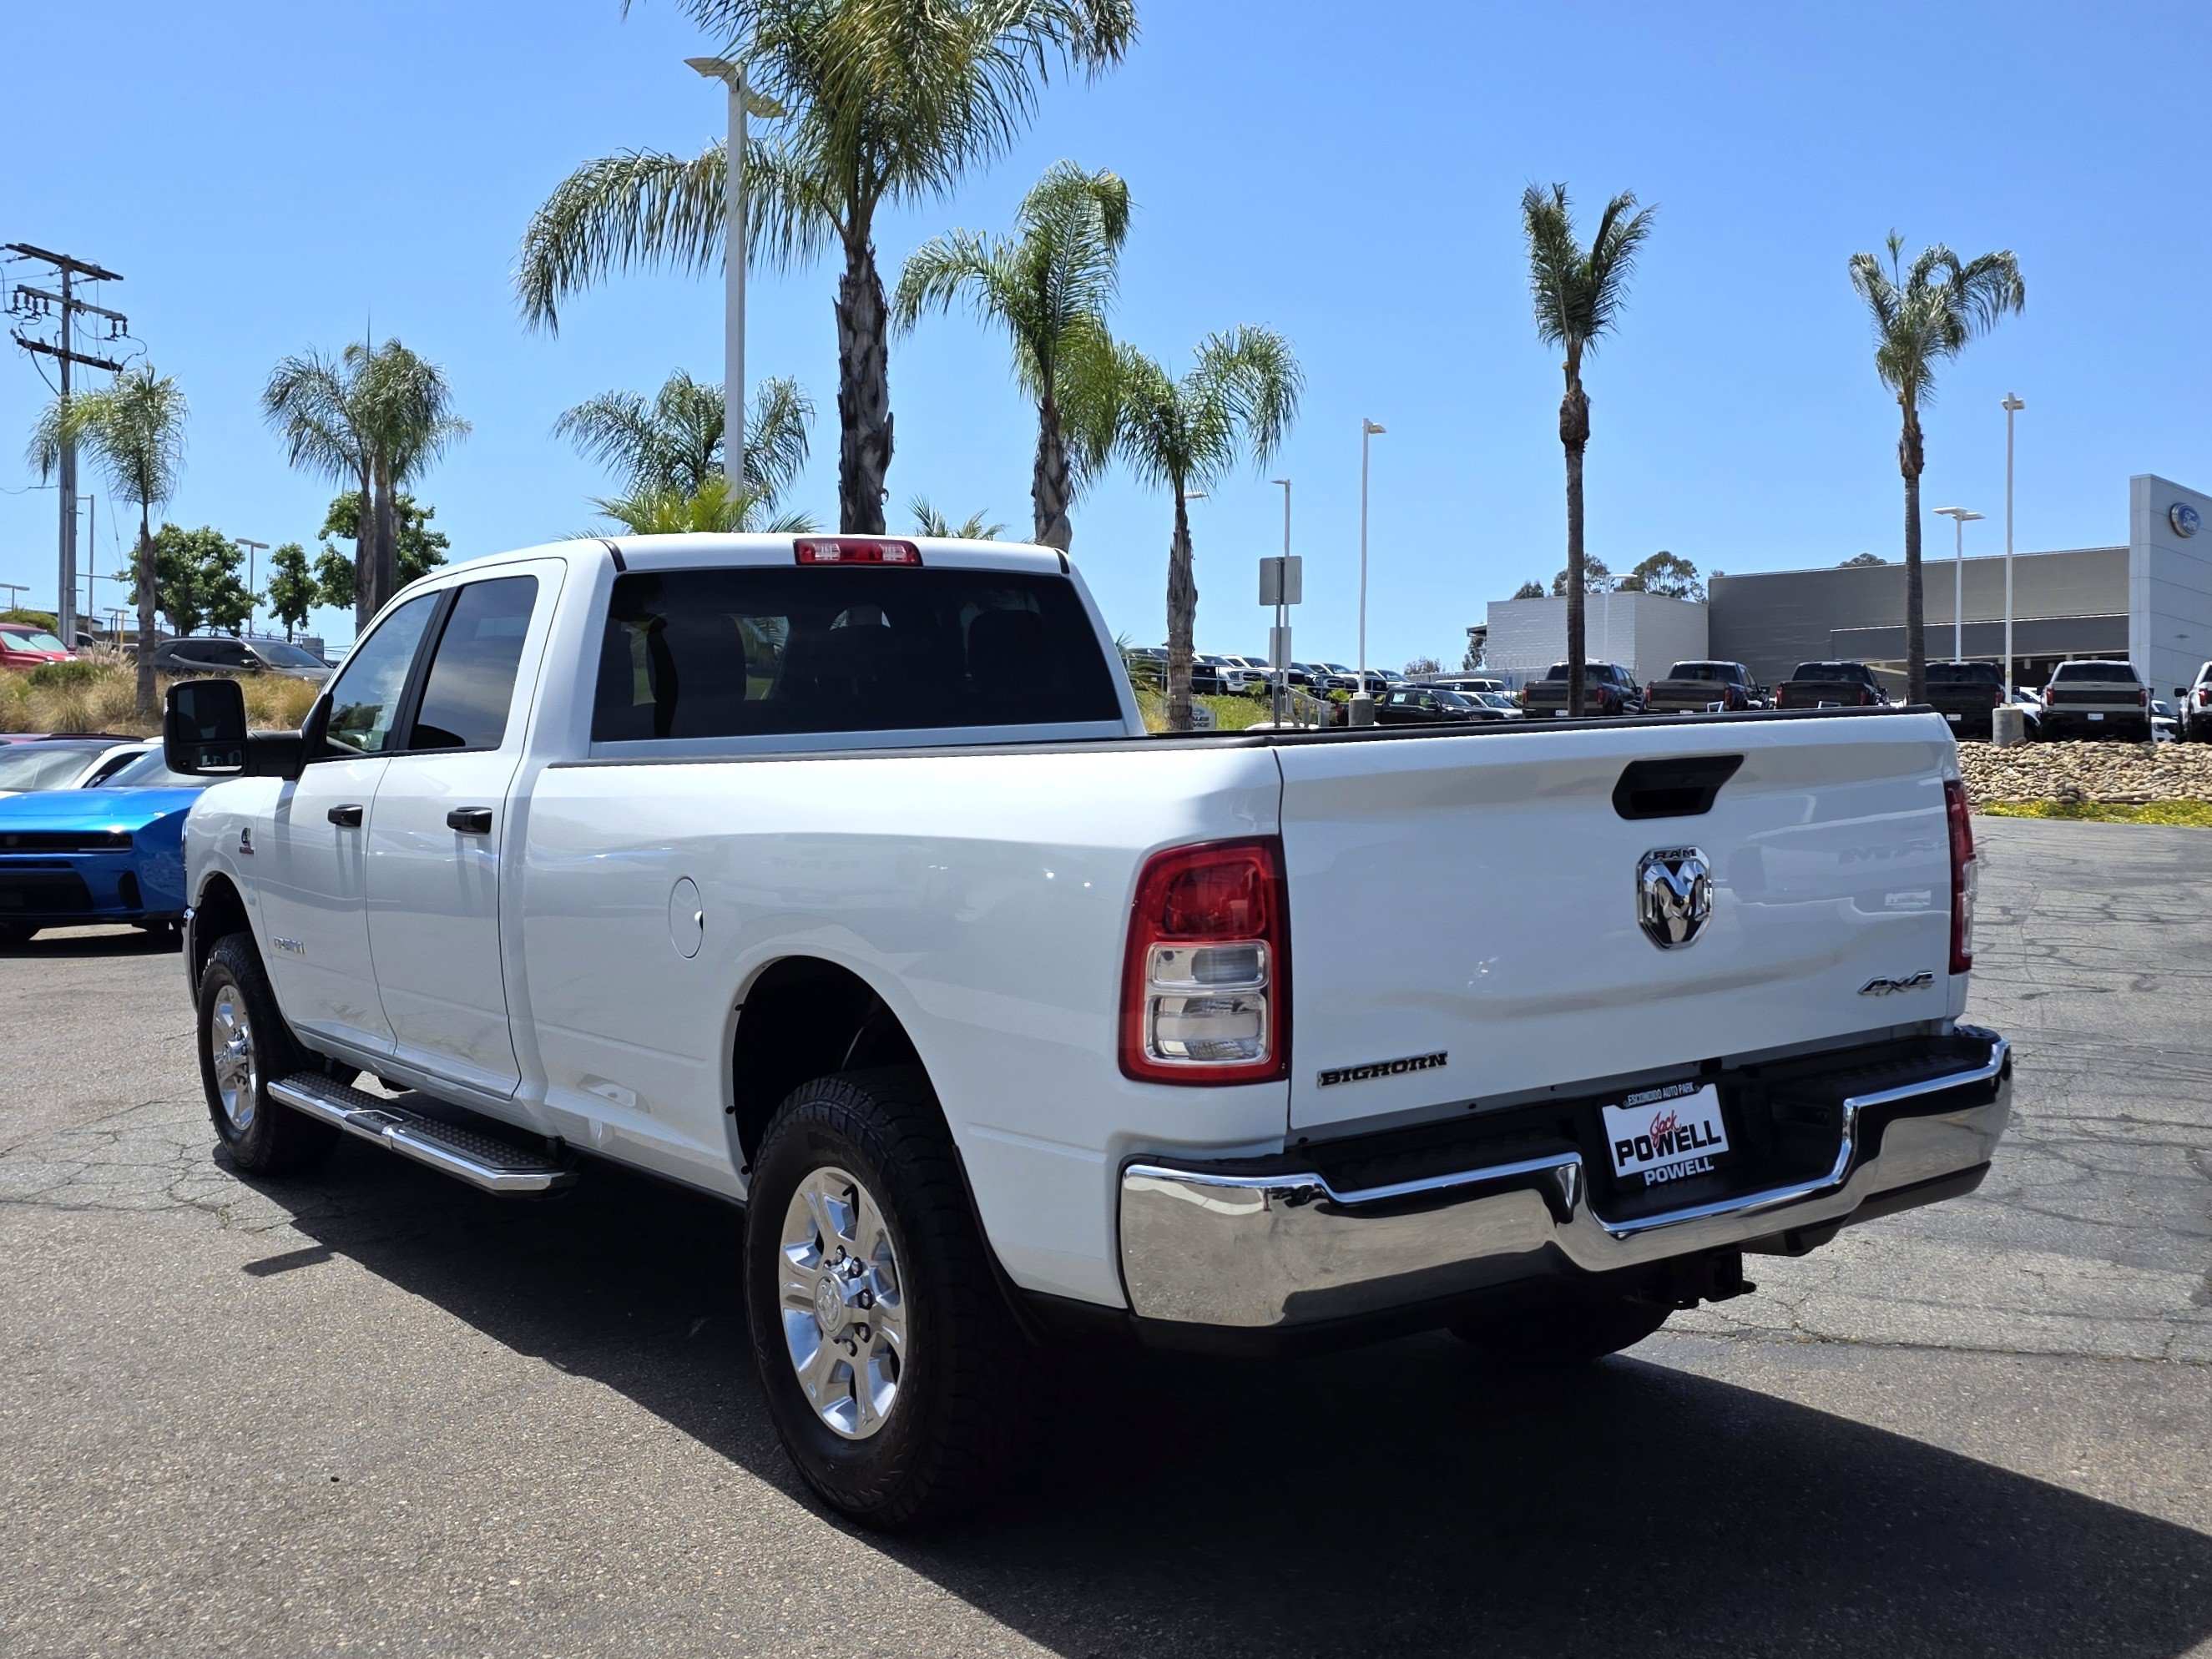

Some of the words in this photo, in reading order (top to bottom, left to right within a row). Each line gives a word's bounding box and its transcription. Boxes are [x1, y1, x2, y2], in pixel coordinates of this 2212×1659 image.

[1653, 848, 1697, 860] RAM
[1316, 1050, 1448, 1089] BIGHORN
[1663, 1085, 1679, 1099] AUTO
[1678, 1082, 1694, 1095] PARK
[1615, 1120, 1721, 1166] POWELL
[1649, 1110, 1681, 1148] Jack
[1644, 1157, 1715, 1186] POWELL
